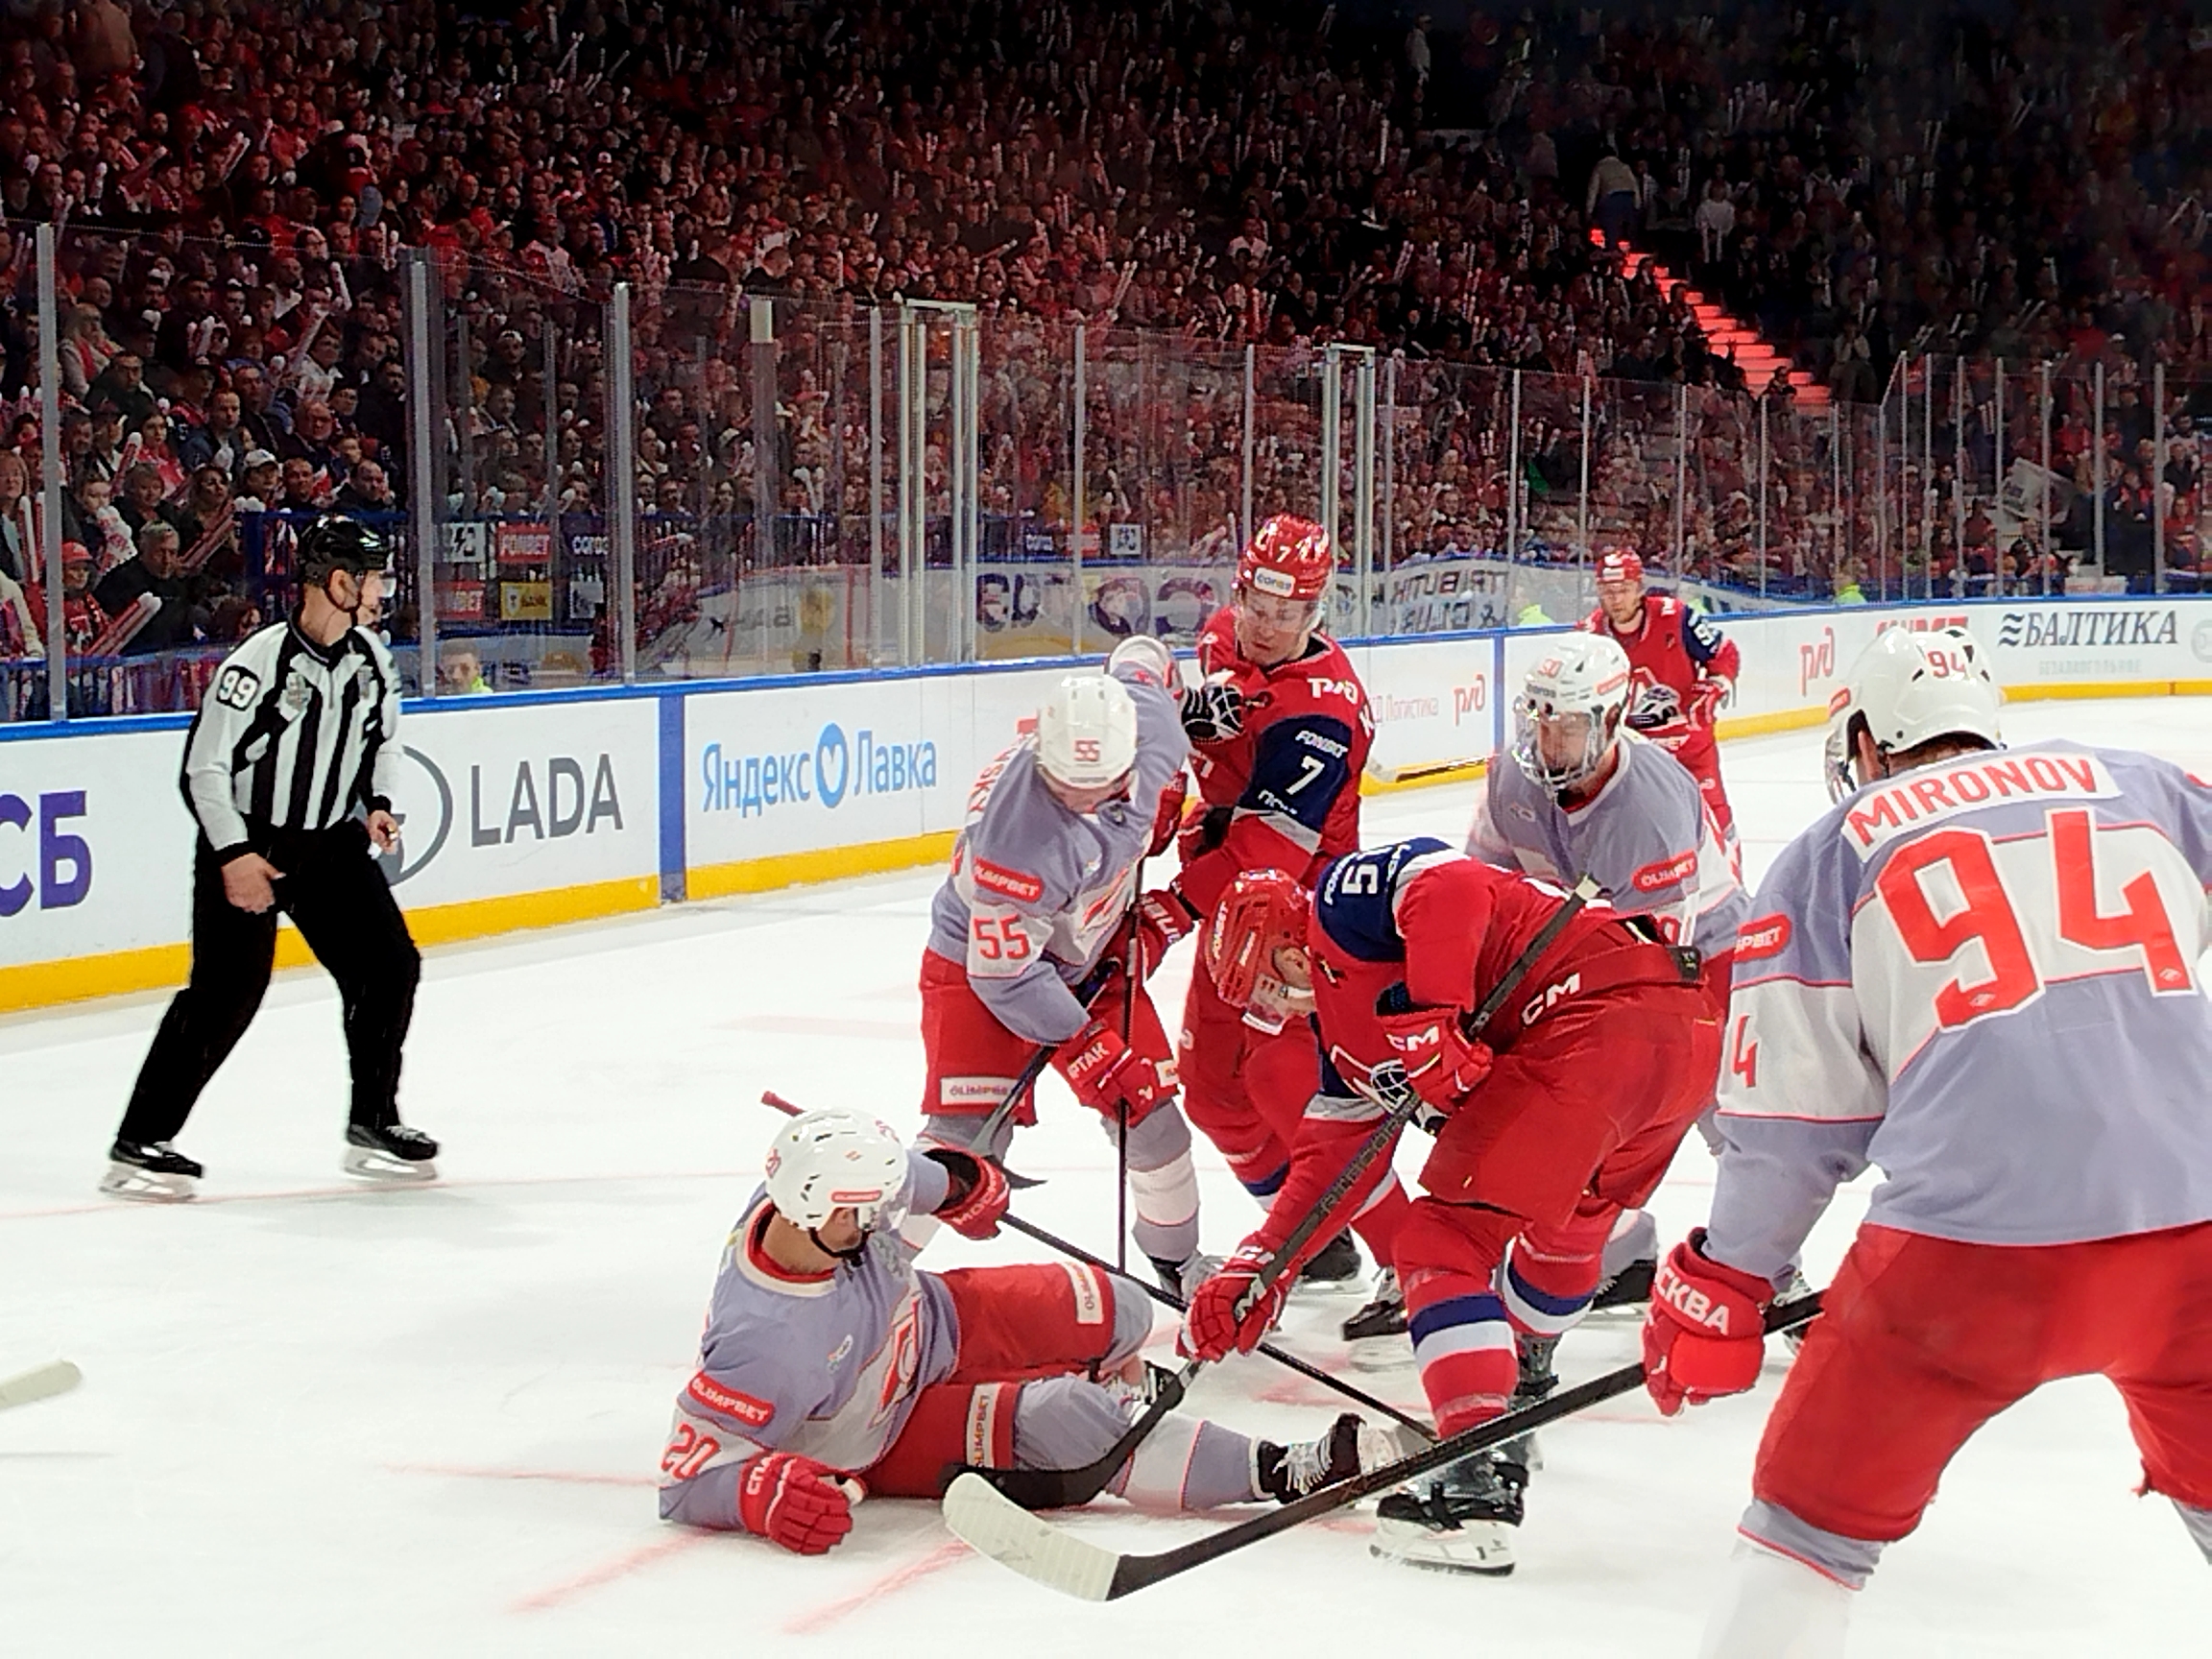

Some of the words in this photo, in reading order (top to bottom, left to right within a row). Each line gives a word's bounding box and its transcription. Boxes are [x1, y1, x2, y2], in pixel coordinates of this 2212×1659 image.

[2023, 610, 2178, 647] БАЛТИКА
[218, 670, 257, 709] 99
[470, 753, 624, 848] LADA
[702, 743, 811, 818] Яндекс
[853, 730, 938, 797] Лавка
[1286, 756, 1326, 796] 7
[1846, 753, 2097, 847] MIRONOV
[974, 914, 1031, 960] 55
[1879, 810, 2193, 1029] 94
[661, 1422, 722, 1481] 20
